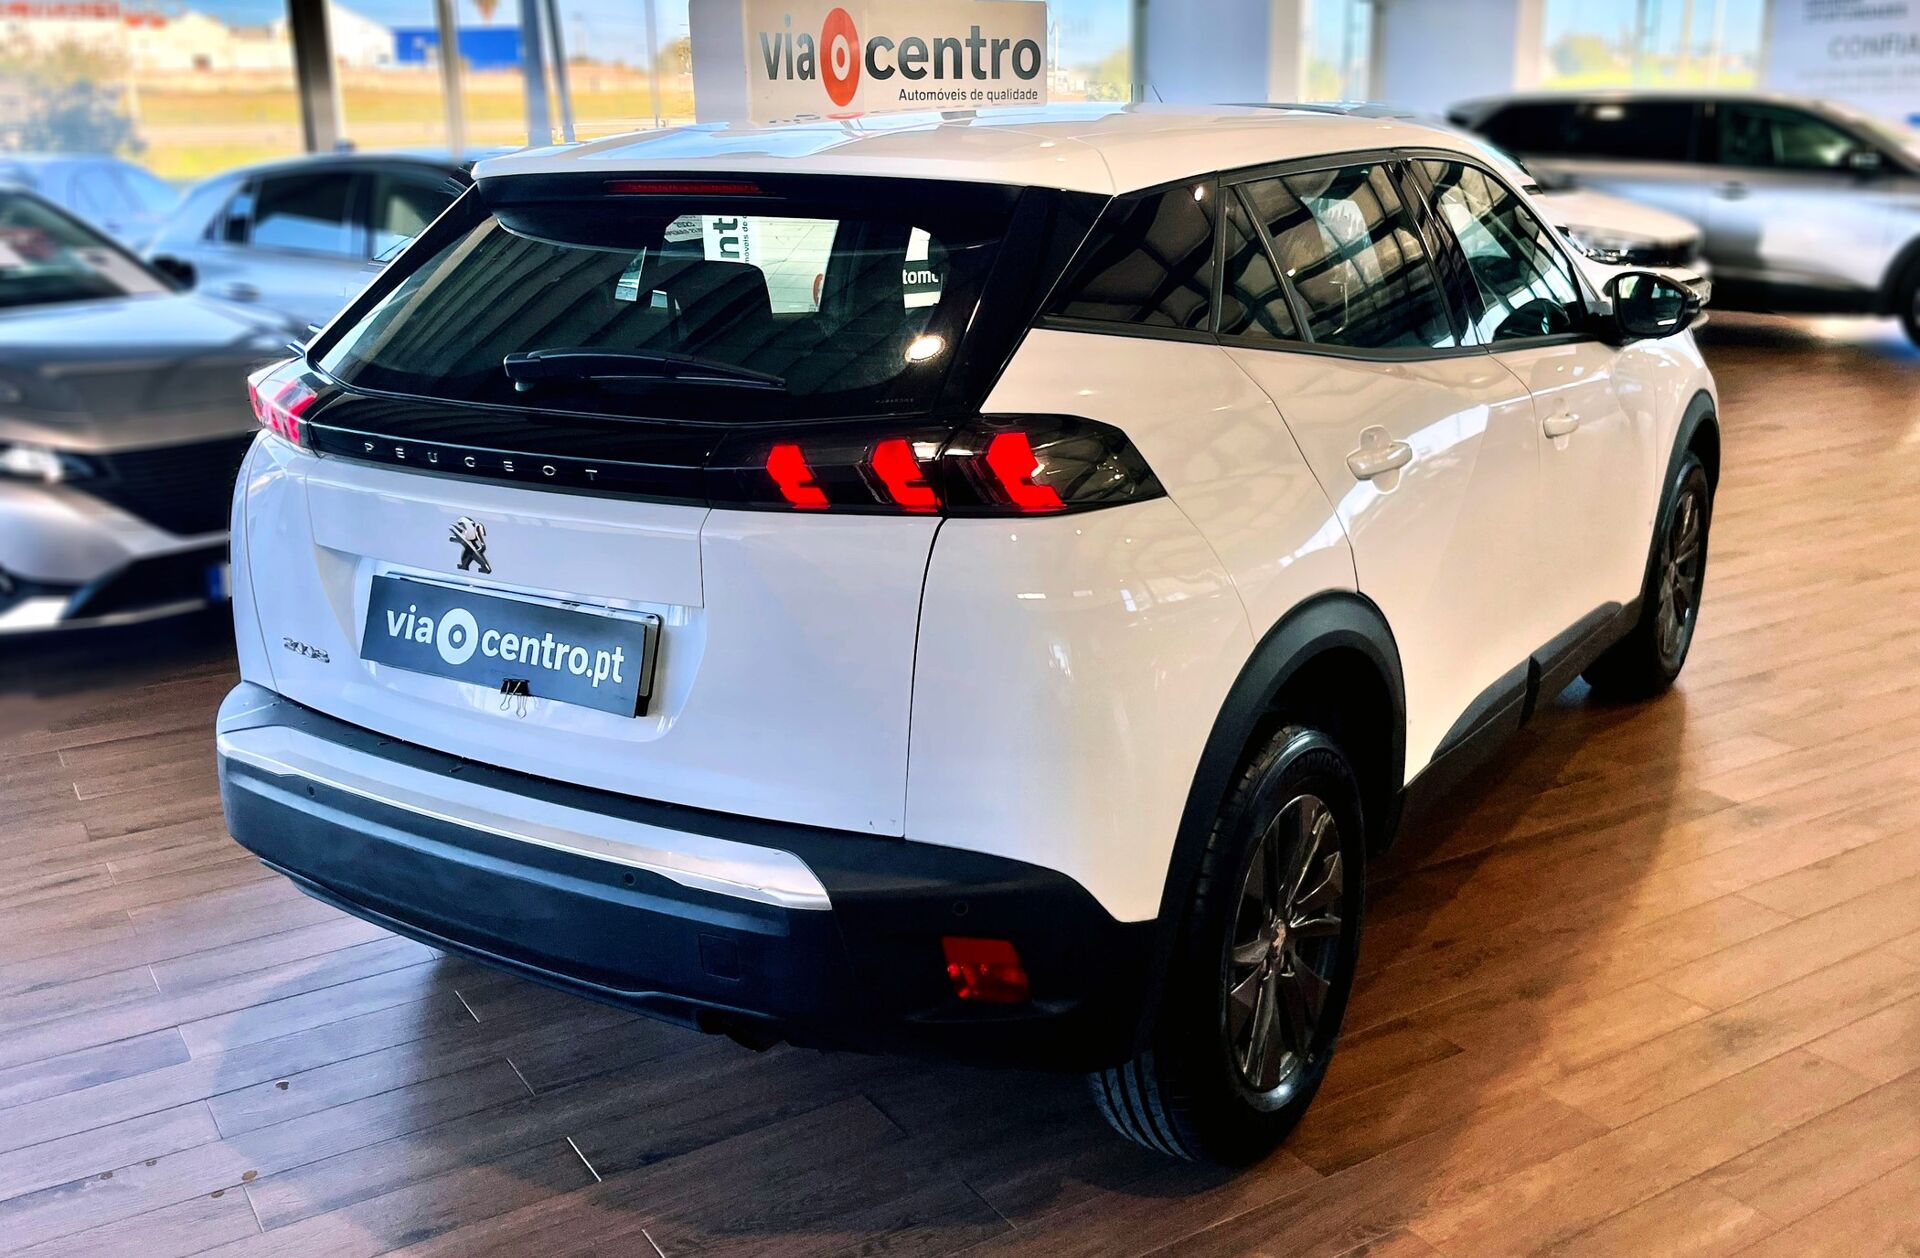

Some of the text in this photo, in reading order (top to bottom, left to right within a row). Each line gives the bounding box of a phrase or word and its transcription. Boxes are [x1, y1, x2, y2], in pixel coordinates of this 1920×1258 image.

[759, 13, 1041, 80] via centro
[899, 88, 1039, 103] Automóveis de qualidade
[364, 442, 598, 481] PEUGEOT
[283, 637, 330, 663] 2008
[386, 604, 624, 687] via centro.pt
